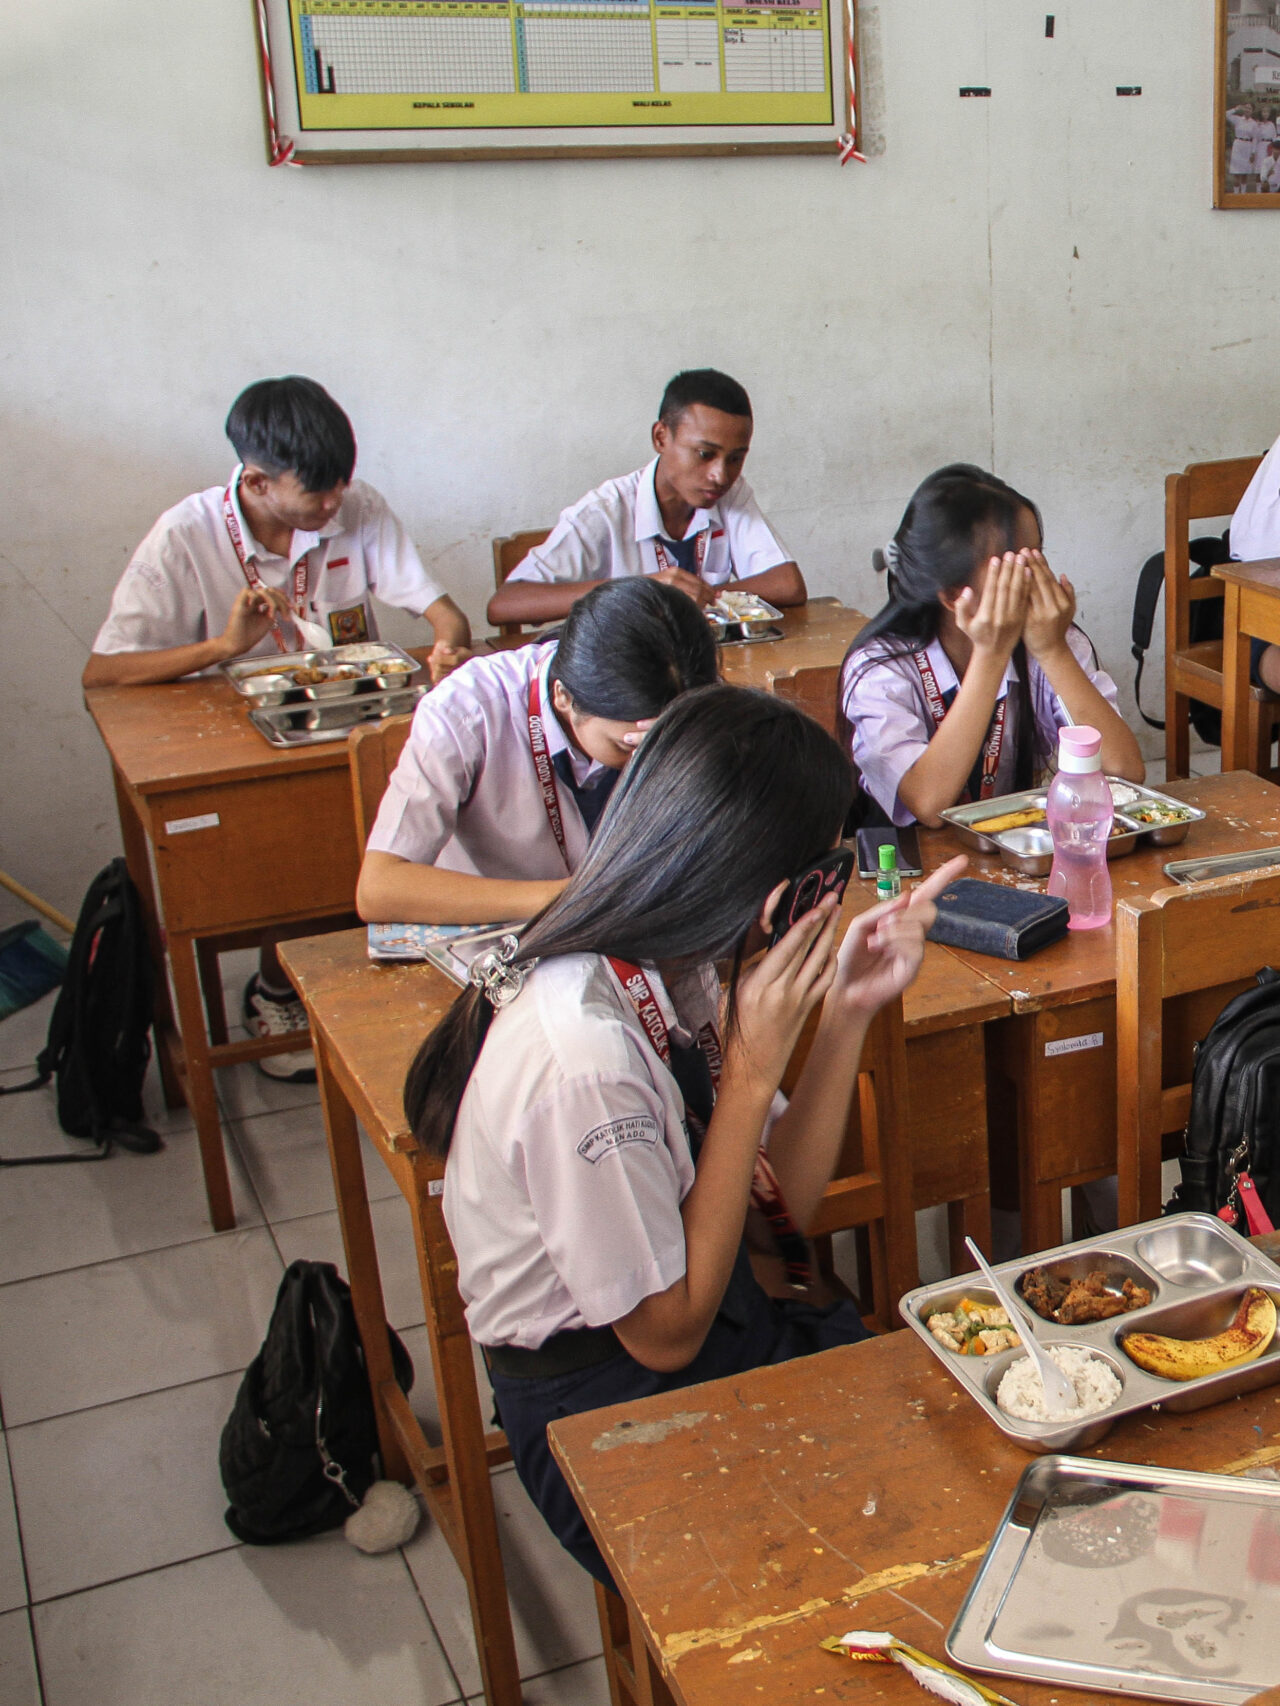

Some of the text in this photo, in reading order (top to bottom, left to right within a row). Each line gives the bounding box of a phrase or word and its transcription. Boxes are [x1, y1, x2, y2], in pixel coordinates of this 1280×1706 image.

[922, 671, 939, 698] KUDUS
[529, 715, 546, 752] MANADO
[987, 724, 1002, 757] MANADO
[535, 754, 553, 782] KUDUS
[626, 974, 668, 1052] SMP KATOLIK
[581, 1138, 594, 1154] SMP
[595, 1124, 624, 1141] KATOLIK
[606, 1131, 645, 1145] MANADO
